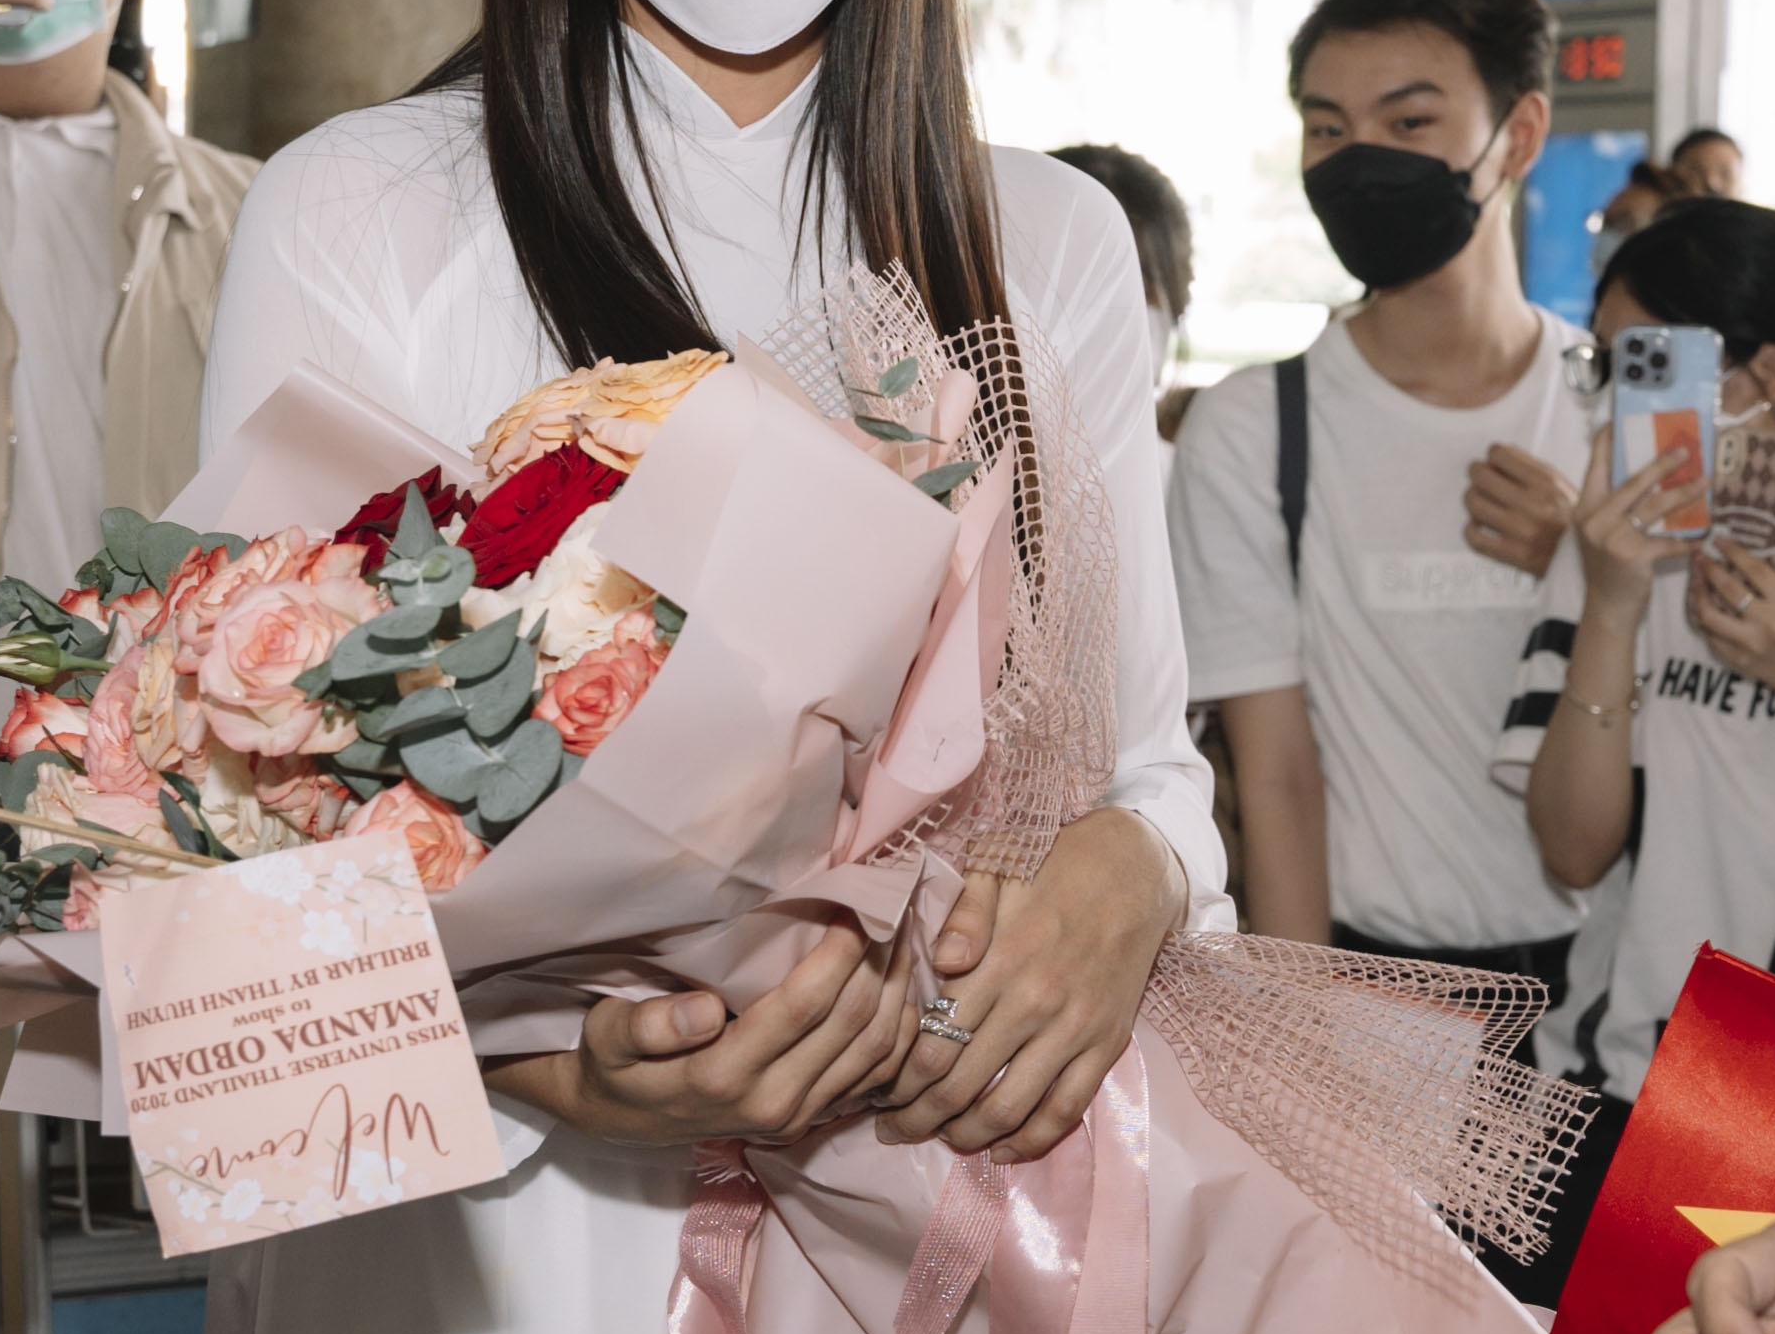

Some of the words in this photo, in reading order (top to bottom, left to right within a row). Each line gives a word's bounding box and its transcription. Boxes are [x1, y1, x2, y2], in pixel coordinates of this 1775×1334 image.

[1657, 655, 1744, 715] HAVE
[323, 939, 432, 981] BRILHAR
[198, 977, 286, 1011] THANH
[288, 967, 318, 992] BY
[126, 1000, 196, 1031] HUYNH
[232, 1003, 284, 1027] show
[271, 988, 442, 1052] AMANDA
[288, 997, 313, 1016] to
[406, 1019, 461, 1053] MISS
[132, 1035, 267, 1090] OBDAM
[290, 1034, 403, 1080] UNIVERSE
[130, 1090, 172, 1114] 2020
[174, 1065, 286, 1107] THAILAND
[184, 1083, 452, 1201] Welcome
